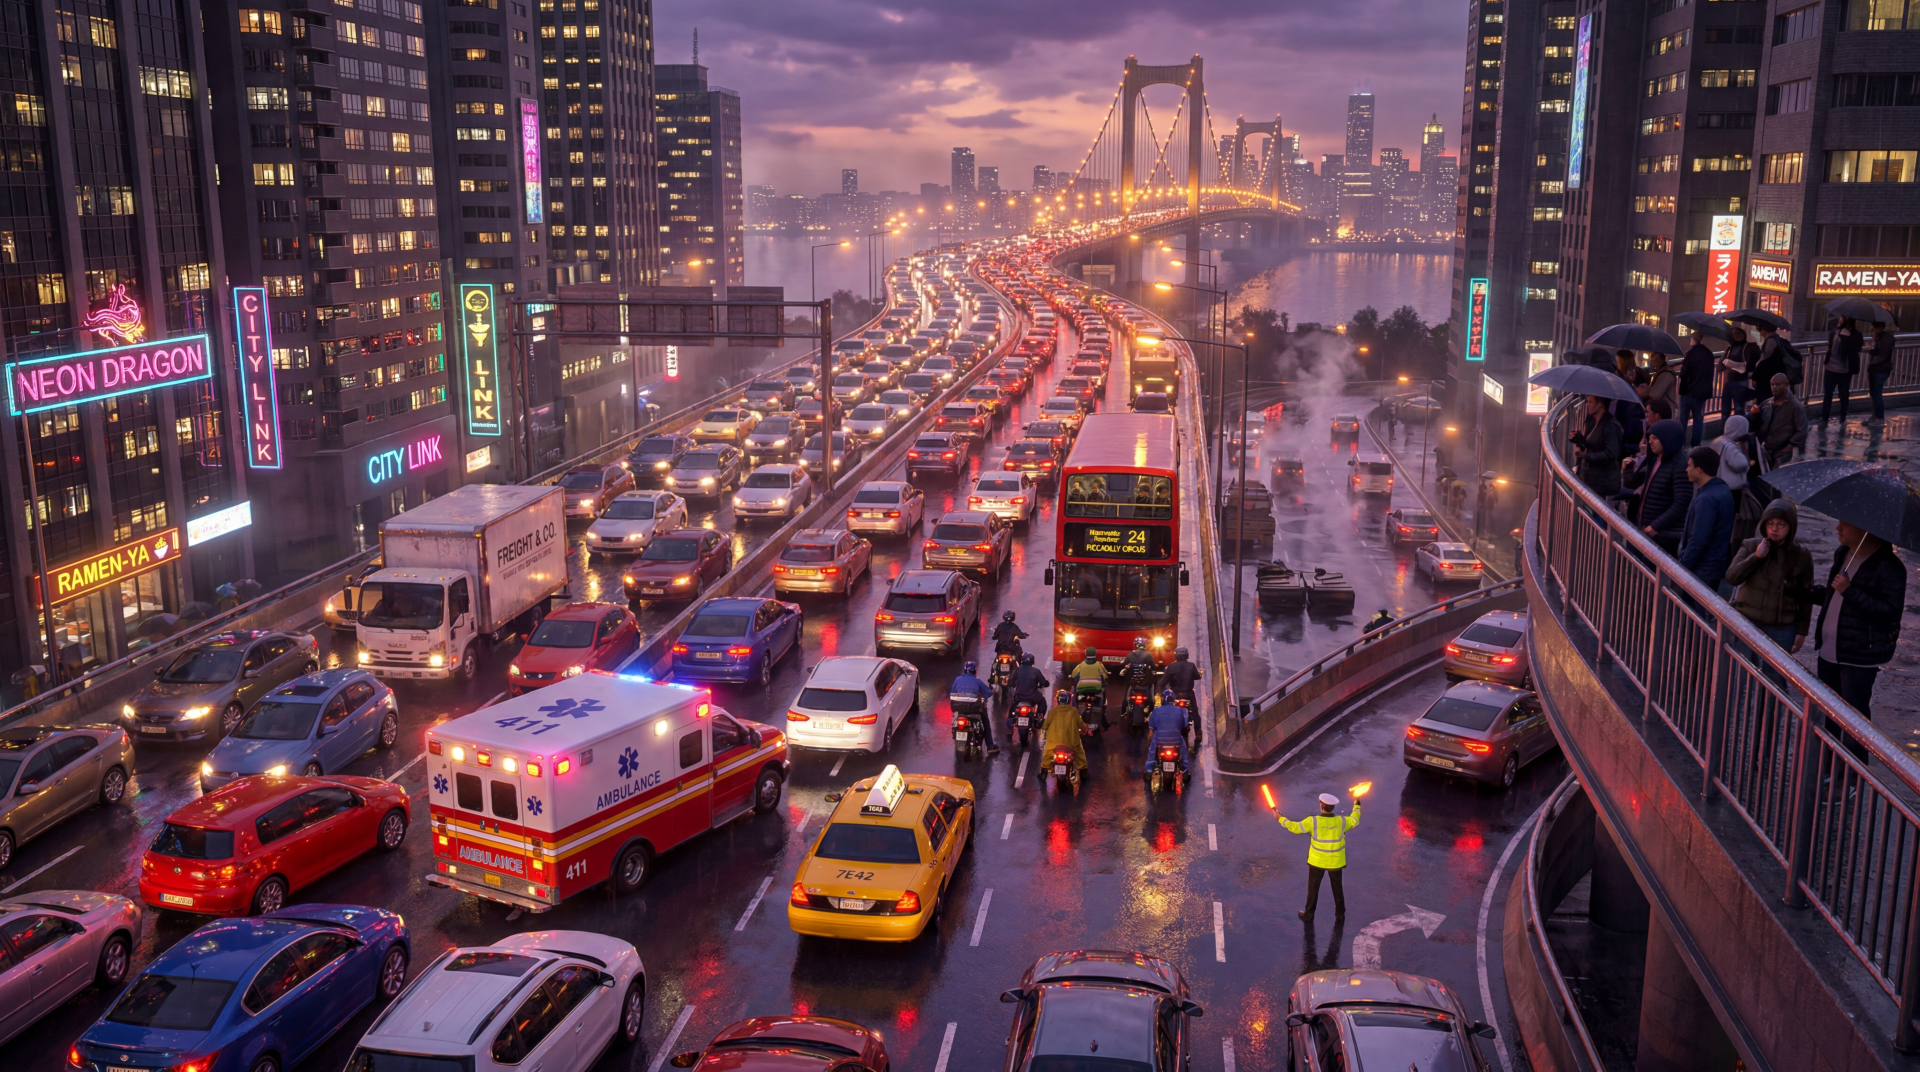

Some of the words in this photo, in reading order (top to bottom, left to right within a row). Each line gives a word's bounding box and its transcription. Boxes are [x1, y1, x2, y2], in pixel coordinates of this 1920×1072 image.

[1751, 264, 1788, 284] RAMEN-YA
[1819, 270, 1920, 286] RAMEN-YA
[18, 360, 97, 402] NEON
[101, 343, 203, 388] DRAGON
[242, 294, 264, 373] CITY
[253, 383, 272, 461] LINK
[474, 359, 494, 420] LINK
[368, 446, 404, 484] CITY
[408, 434, 443, 470] LINK
[497, 532, 533, 568] FREIGHT
[535, 529, 542, 547] &
[543, 521, 557, 543] CO.
[1128, 530, 1146, 544] 24
[57, 544, 150, 595] RAMEN-YA
[495, 716, 561, 735] 411
[596, 769, 661, 811] AMBULANCE
[459, 844, 524, 874] AMBULANCE
[565, 859, 588, 881] 411
[835, 869, 875, 881] 7E42
